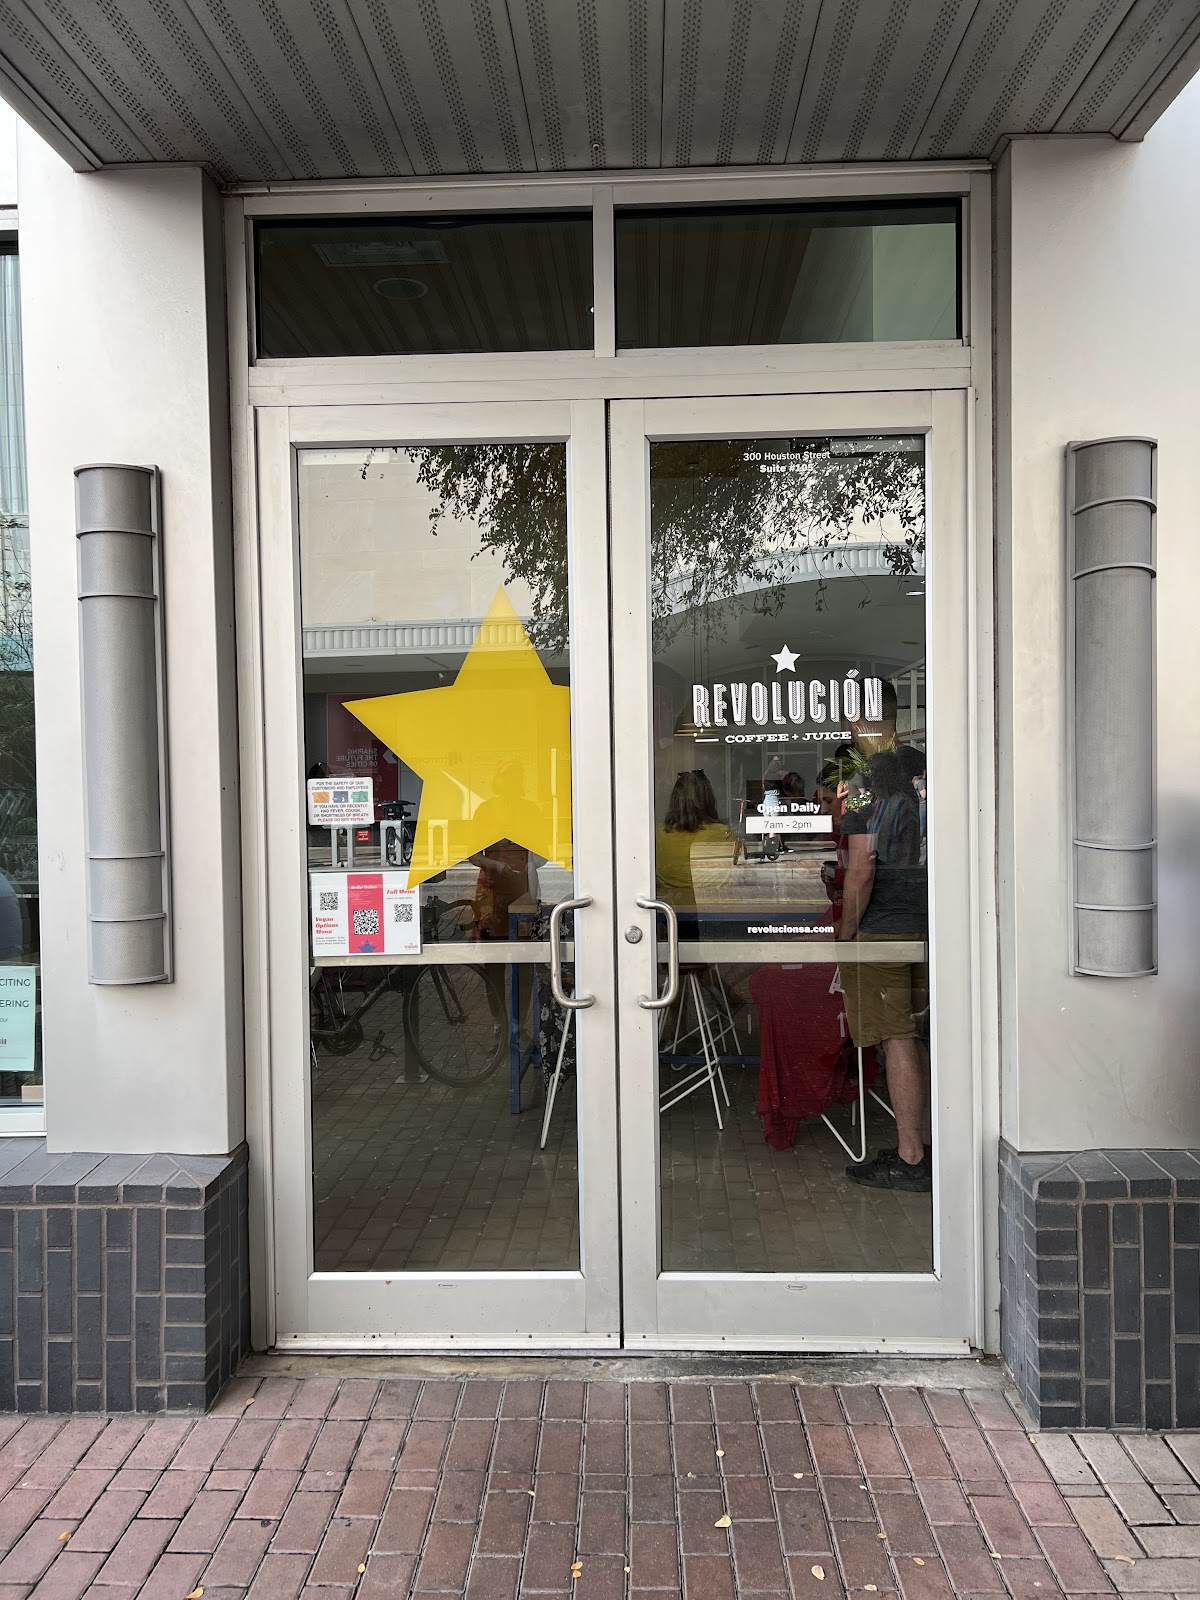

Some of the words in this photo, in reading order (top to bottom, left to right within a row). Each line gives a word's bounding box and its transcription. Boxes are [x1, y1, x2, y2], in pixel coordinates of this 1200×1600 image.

[743, 452, 762, 461] 300
[764, 451, 801, 461] Houston
[803, 450, 831, 460] Street
[759, 464, 787, 473] Suite
[789, 463, 815, 472] #105
[692, 668, 884, 728] REVOLUCIÓN
[724, 733, 789, 744] COFFEE
[802, 731, 852, 741] JUICE
[756, 803, 788, 815] Open
[790, 802, 821, 814] Daily
[763, 820, 784, 829] 7am
[792, 820, 812, 830] 2pm
[747, 924, 834, 934] revolucionsa.com
